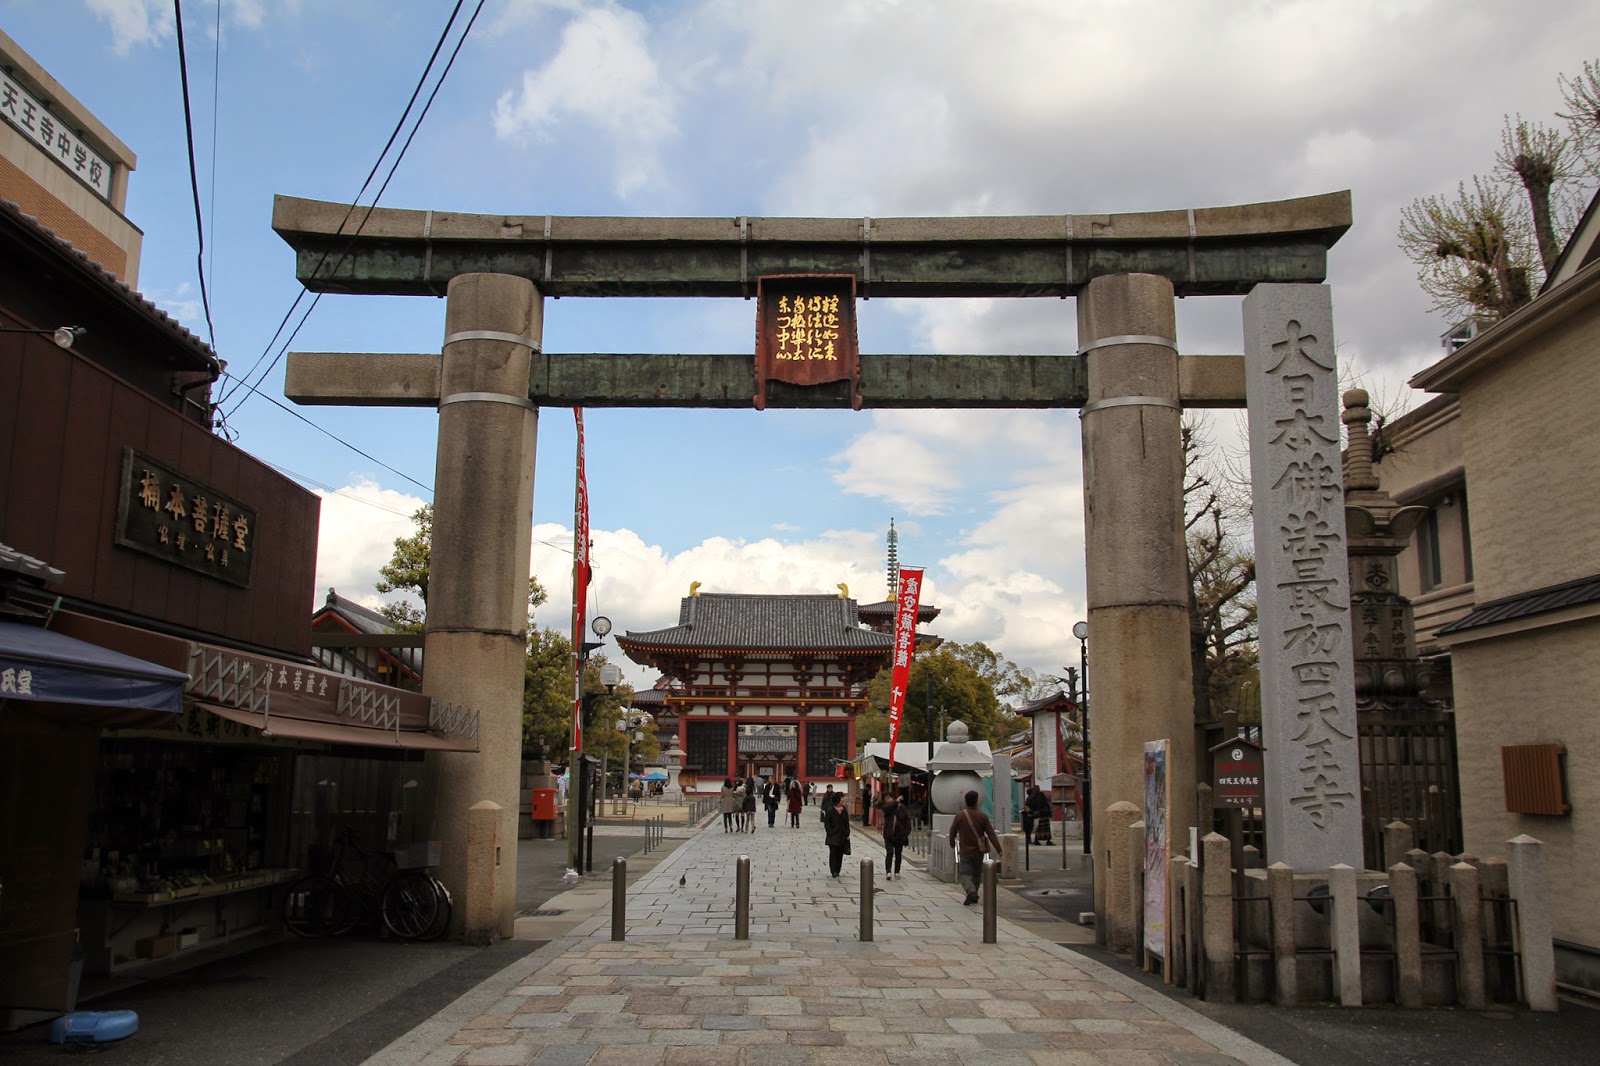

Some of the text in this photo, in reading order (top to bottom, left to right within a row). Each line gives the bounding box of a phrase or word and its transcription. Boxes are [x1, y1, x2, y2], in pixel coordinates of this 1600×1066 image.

[1, 81, 103, 188] 天王寺中学校
[1265, 319, 1355, 833] 大日本佛法最初四天王寺
